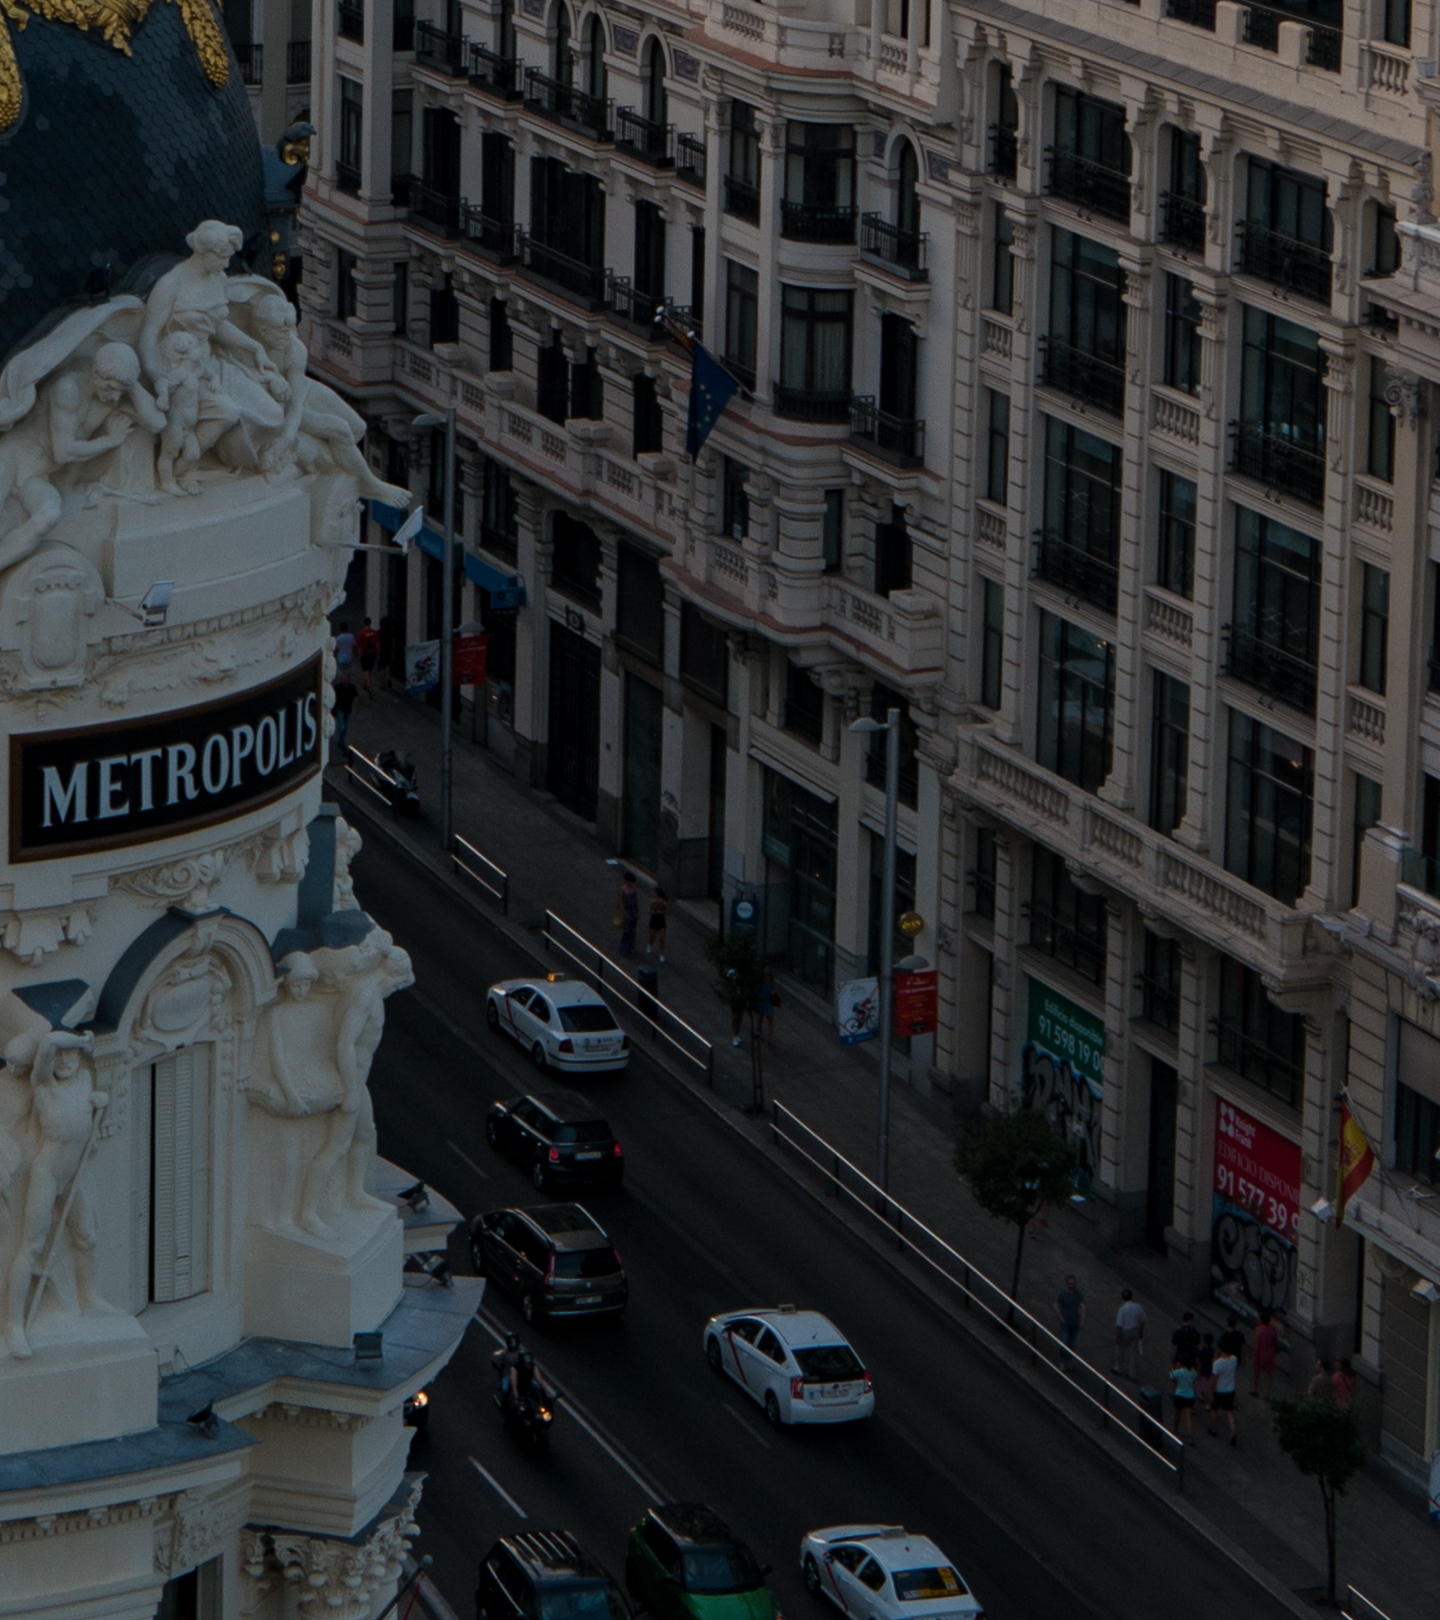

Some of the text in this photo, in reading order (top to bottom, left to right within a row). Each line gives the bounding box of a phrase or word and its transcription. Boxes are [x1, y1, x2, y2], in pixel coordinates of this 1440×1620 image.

[40, 691, 318, 829] METROPOLIS
[1038, 1014, 1051, 1040] 91
[1054, 1025, 1076, 1056] 598
[1078, 1038, 1091, 1064] 19
[1218, 1140, 1257, 1177] EDIFICIO
[1218, 1164, 1234, 1196] 91
[1238, 1176, 1265, 1214] 577
[1267, 1196, 1288, 1230] 39
